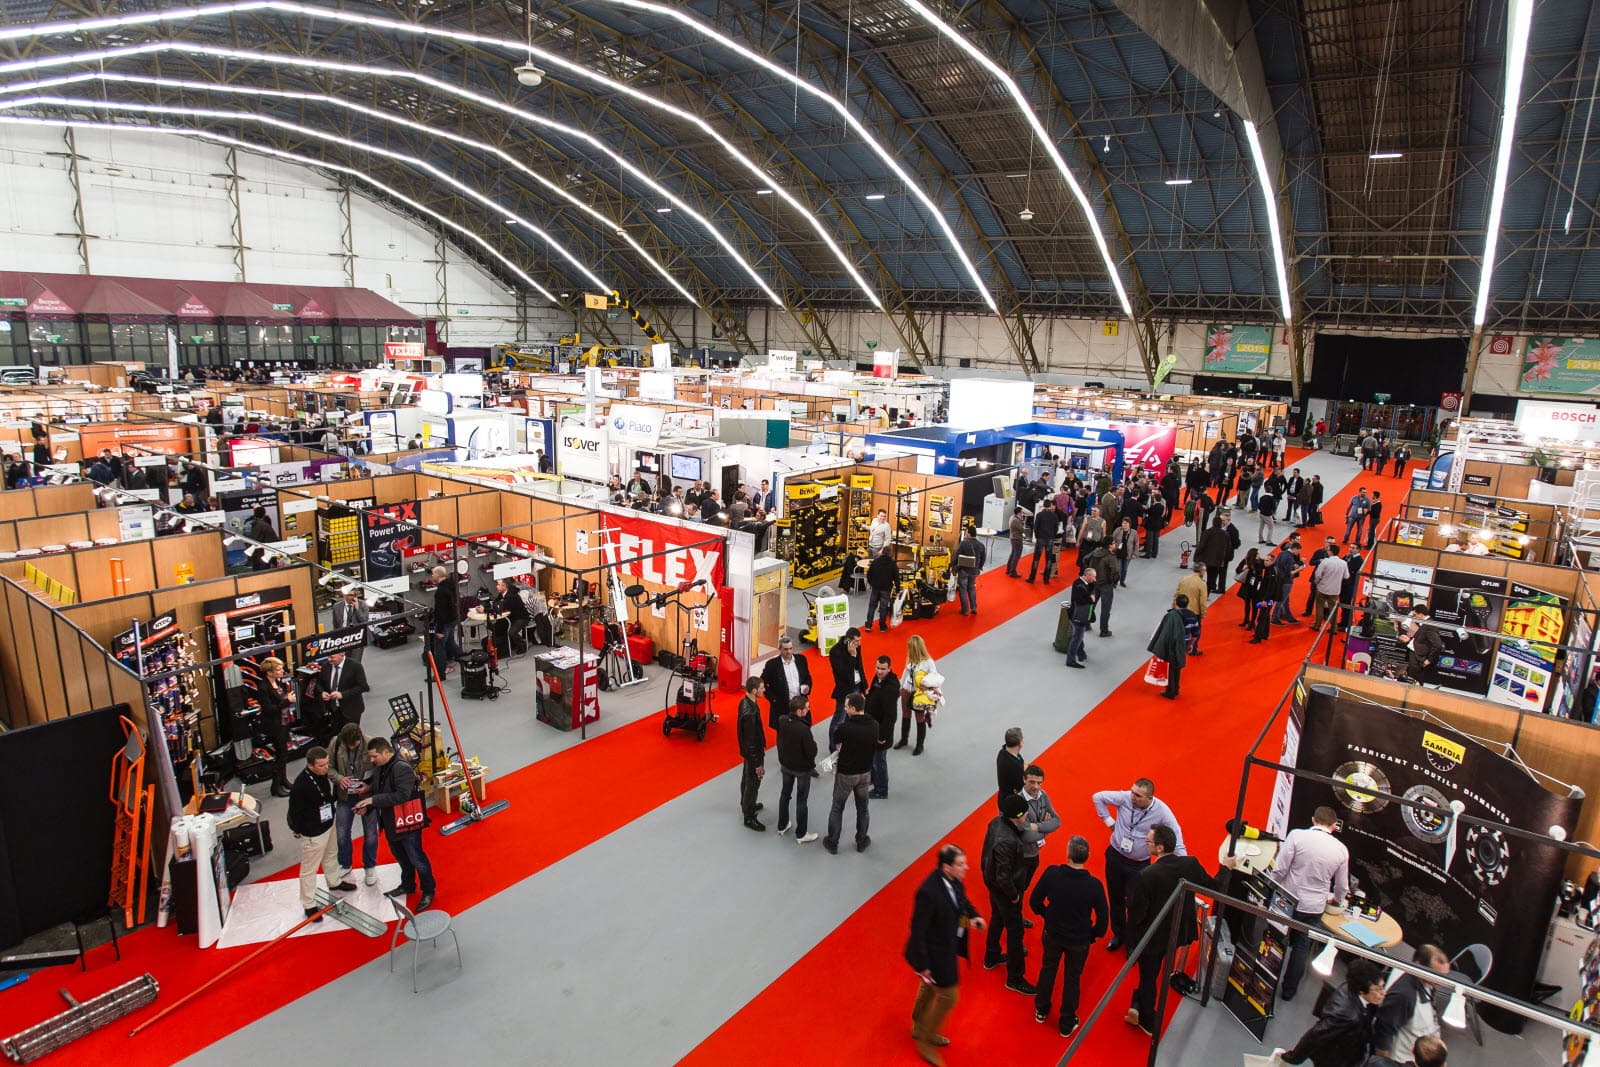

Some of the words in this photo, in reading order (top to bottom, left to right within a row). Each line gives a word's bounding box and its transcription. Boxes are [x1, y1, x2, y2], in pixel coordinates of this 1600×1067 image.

[388, 346, 423, 356] VELUX
[1551, 411, 1597, 423] BOSCH
[629, 421, 652, 433] Placo
[368, 502, 416, 527] FLEX
[369, 526, 396, 538] Power
[620, 532, 720, 598] FLEX
[319, 628, 364, 650] Theard
[1424, 740, 1461, 762] SAMEDIA
[1347, 743, 1408, 767] FABRICANT
[1413, 763, 1459, 790] D'OUTILS
[396, 812, 424, 828] ACO
